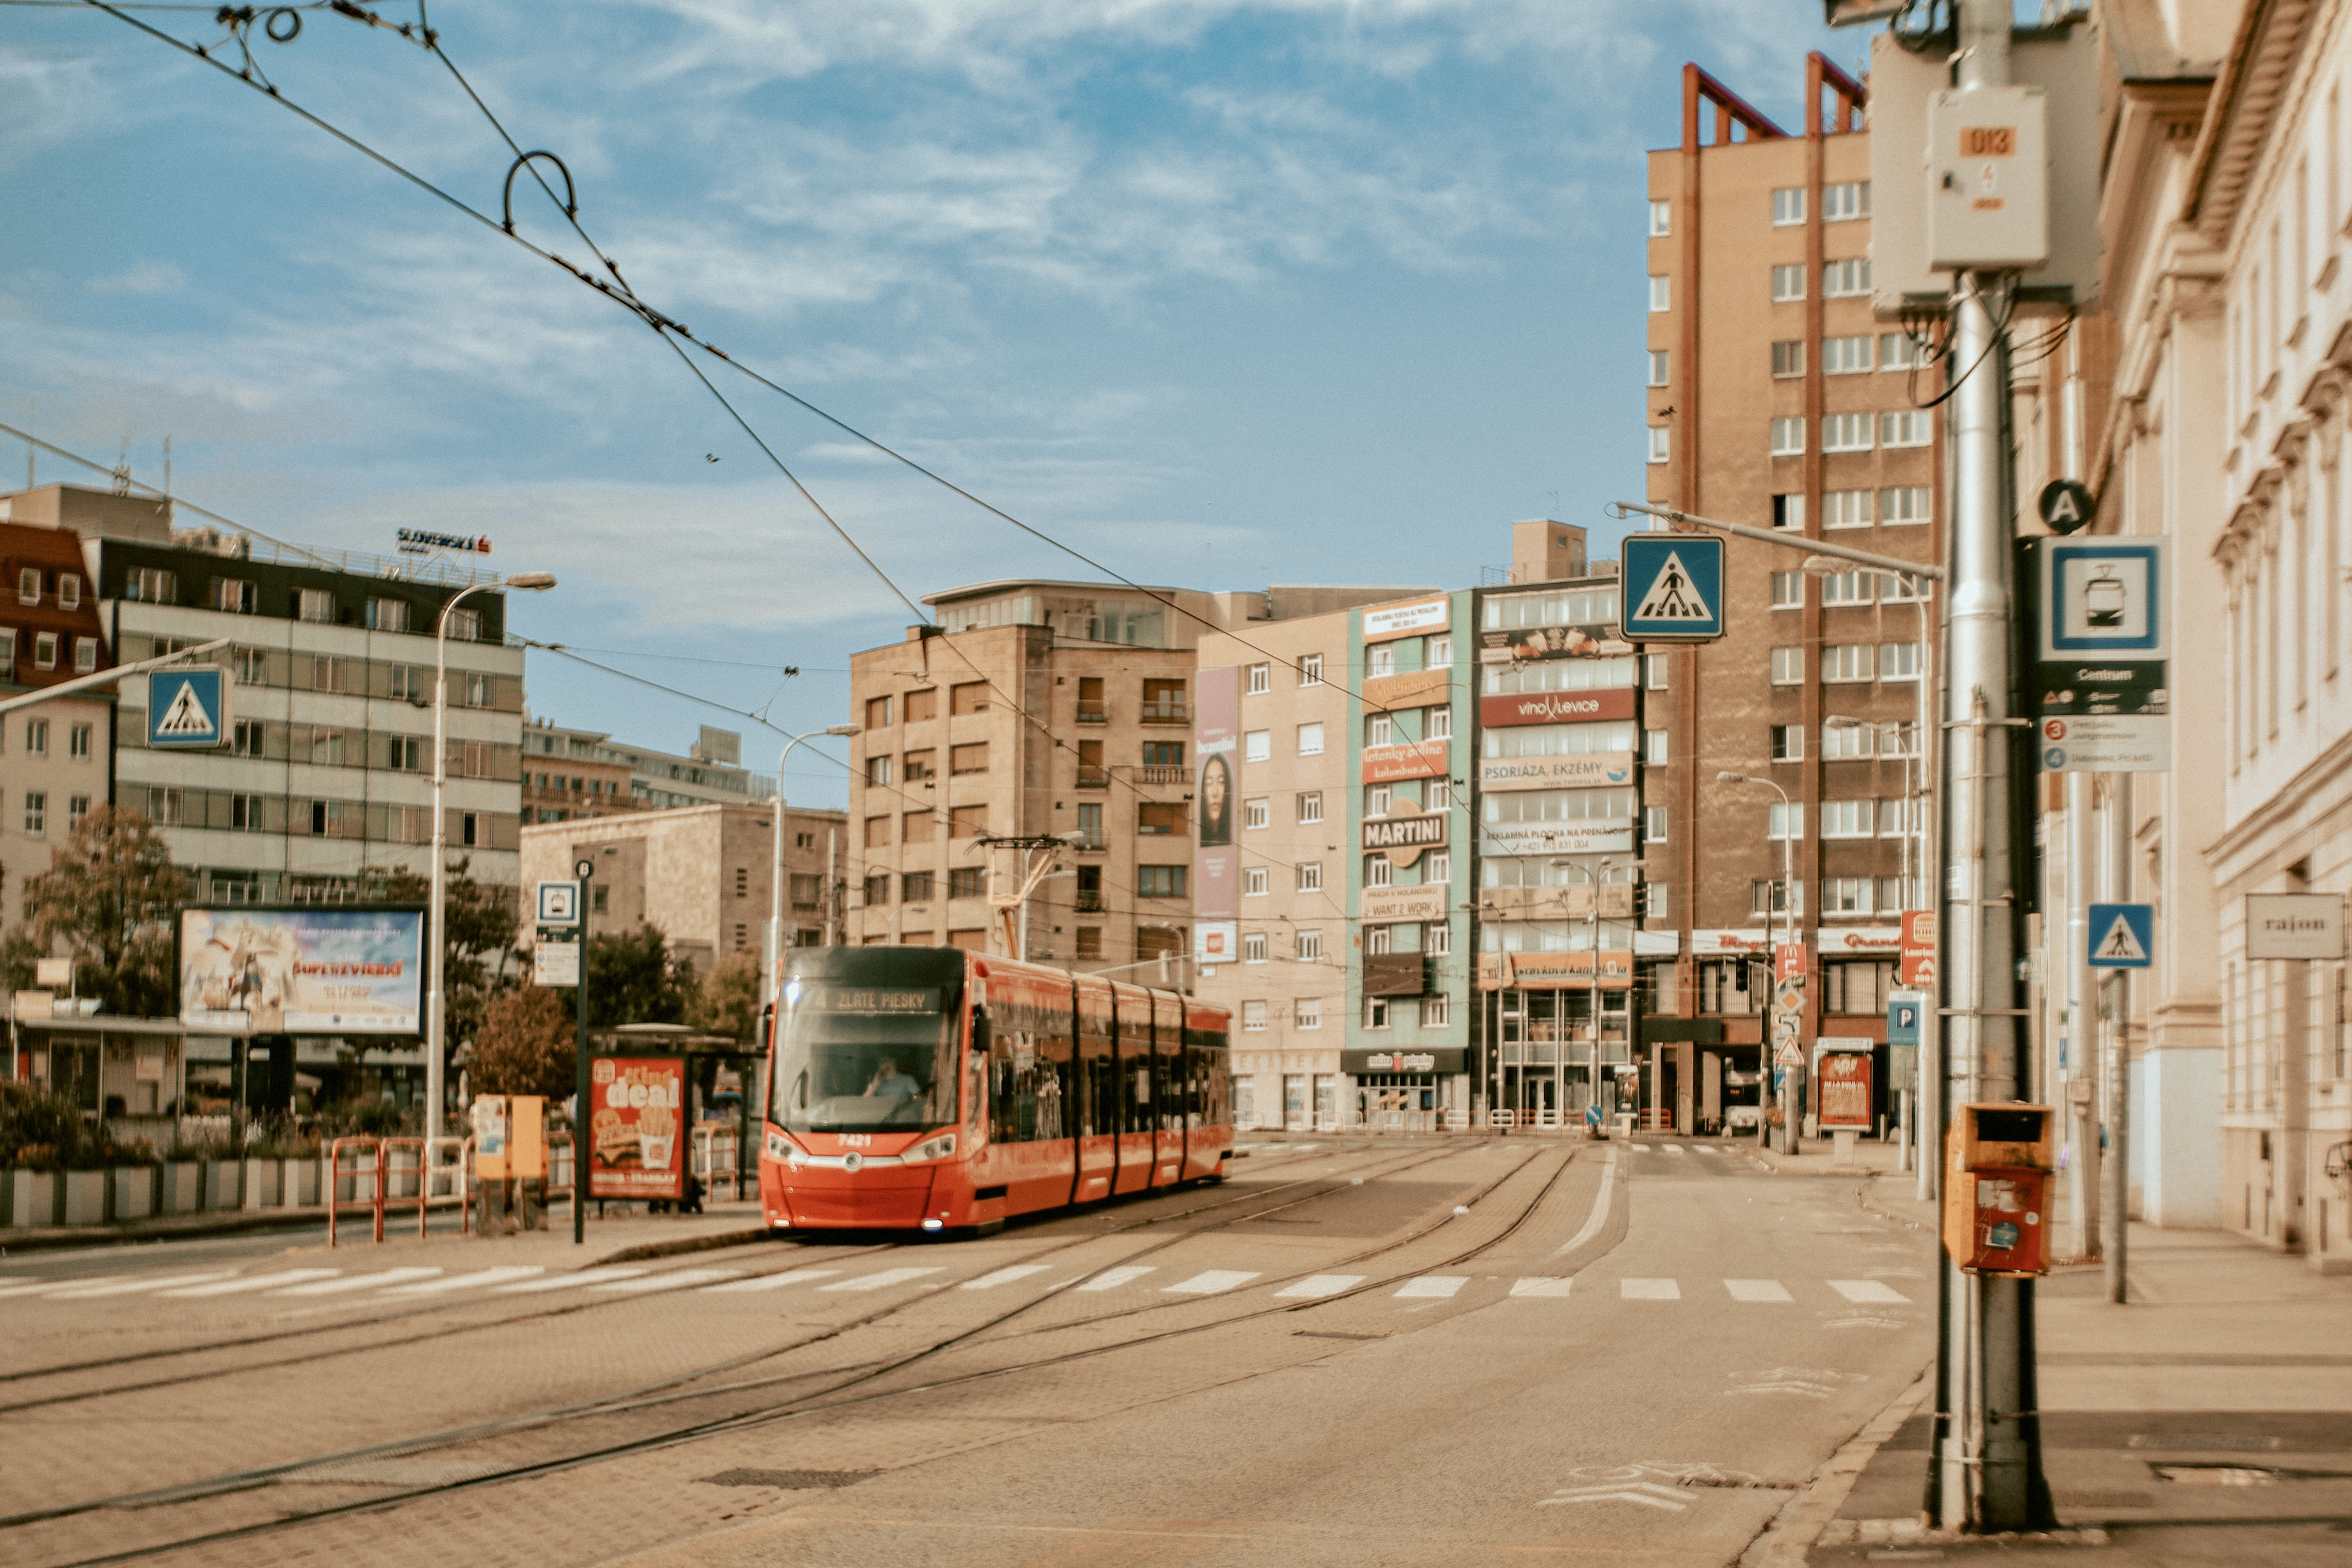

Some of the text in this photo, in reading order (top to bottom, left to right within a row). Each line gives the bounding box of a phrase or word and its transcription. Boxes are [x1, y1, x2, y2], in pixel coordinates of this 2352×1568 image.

[2048, 489, 2080, 521] A
[2077, 668, 2134, 681] Centrum
[1365, 743, 1442, 762] letenky online
[1375, 764, 1432, 778] kolumbus.sk
[1365, 819, 1441, 847] MARTINI
[1531, 830, 1565, 839] PLOCHA
[579, 861, 589, 878] B
[1373, 904, 1396, 915] WANT
[1407, 902, 1432, 914] WORK
[881, 992, 925, 1008] PIESKY
[606, 1077, 680, 1108] deal
[838, 1133, 871, 1147] 7421
